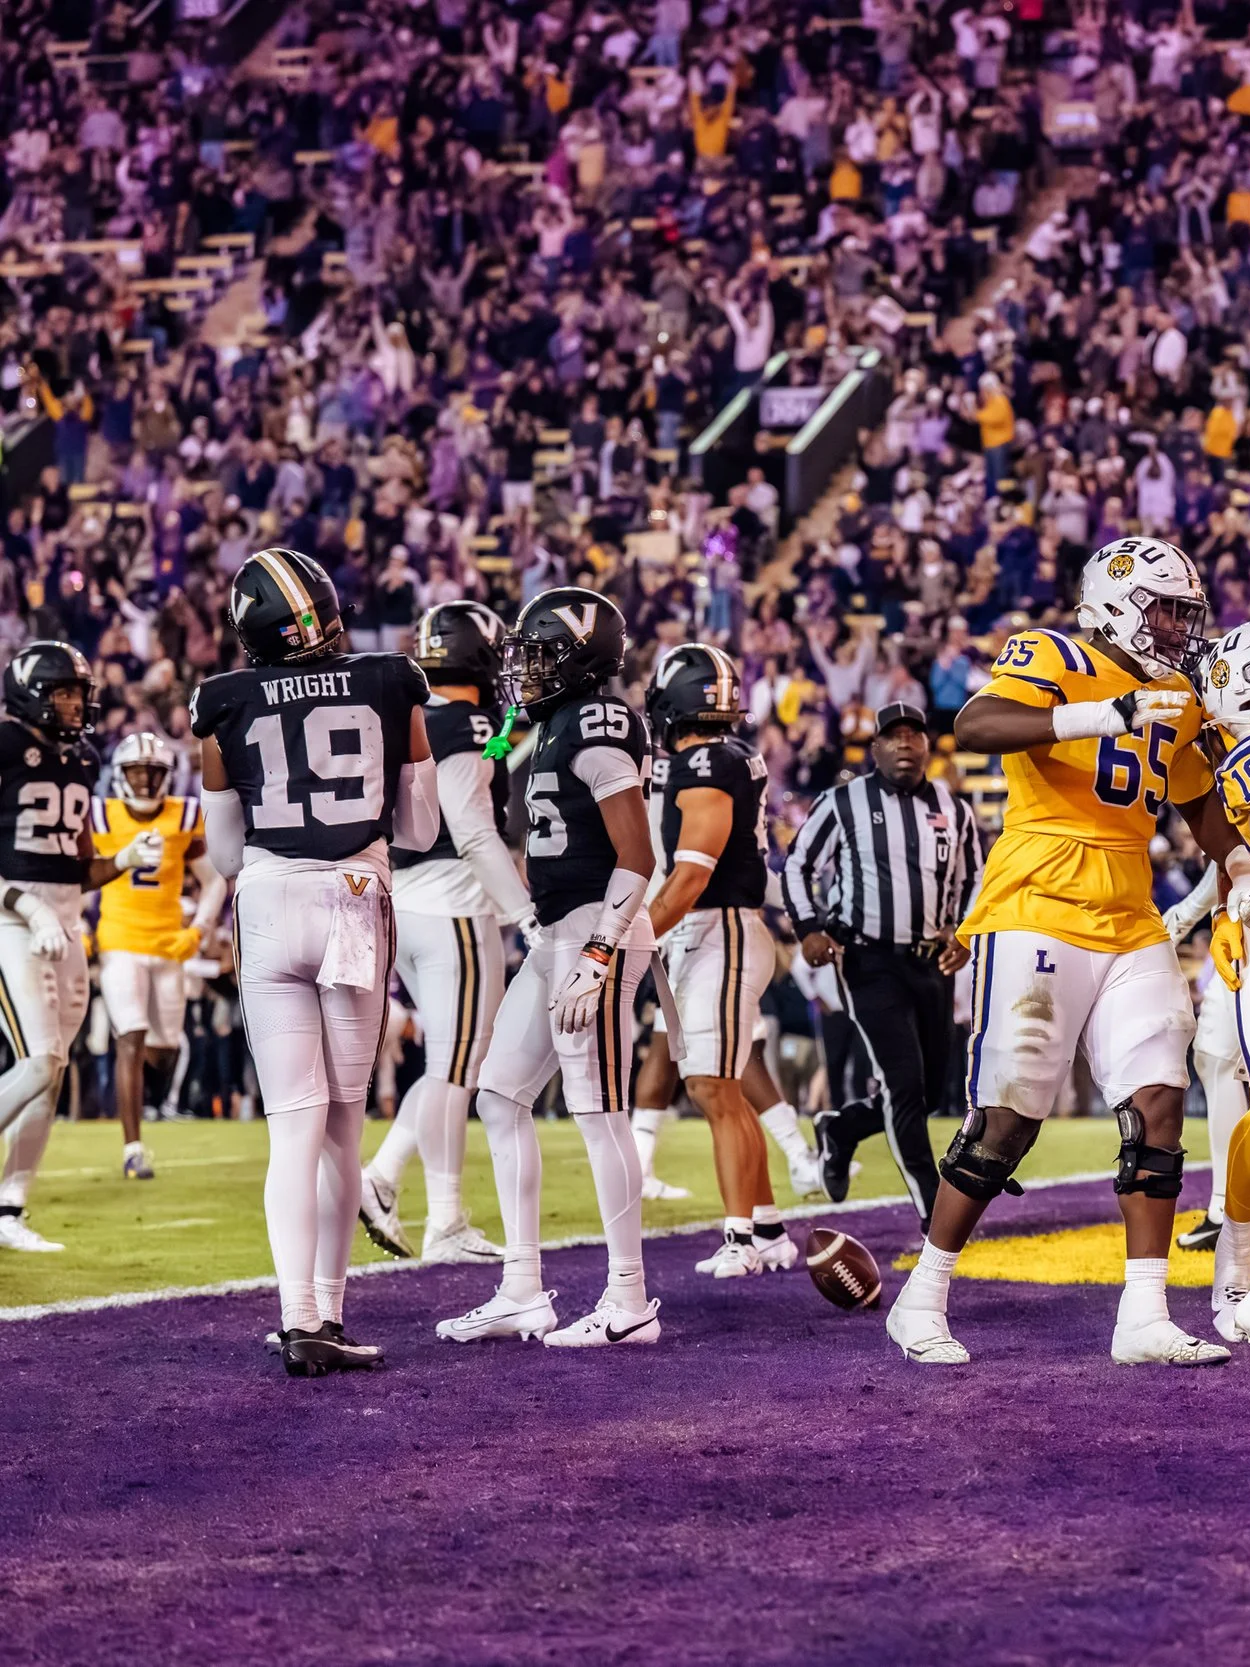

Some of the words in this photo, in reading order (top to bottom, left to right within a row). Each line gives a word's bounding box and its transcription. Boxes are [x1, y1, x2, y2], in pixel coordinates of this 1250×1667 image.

[997, 638, 1039, 667] 65
[261, 672, 351, 705] WRIGHT
[470, 714, 495, 744] 5
[579, 703, 630, 739] 25
[245, 705, 384, 829] 19
[688, 748, 711, 777] 4
[1092, 720, 1178, 818] 65
[14, 782, 90, 856] 29
[873, 811, 883, 824] S
[343, 872, 372, 897] V
[1035, 949, 1056, 974] L
